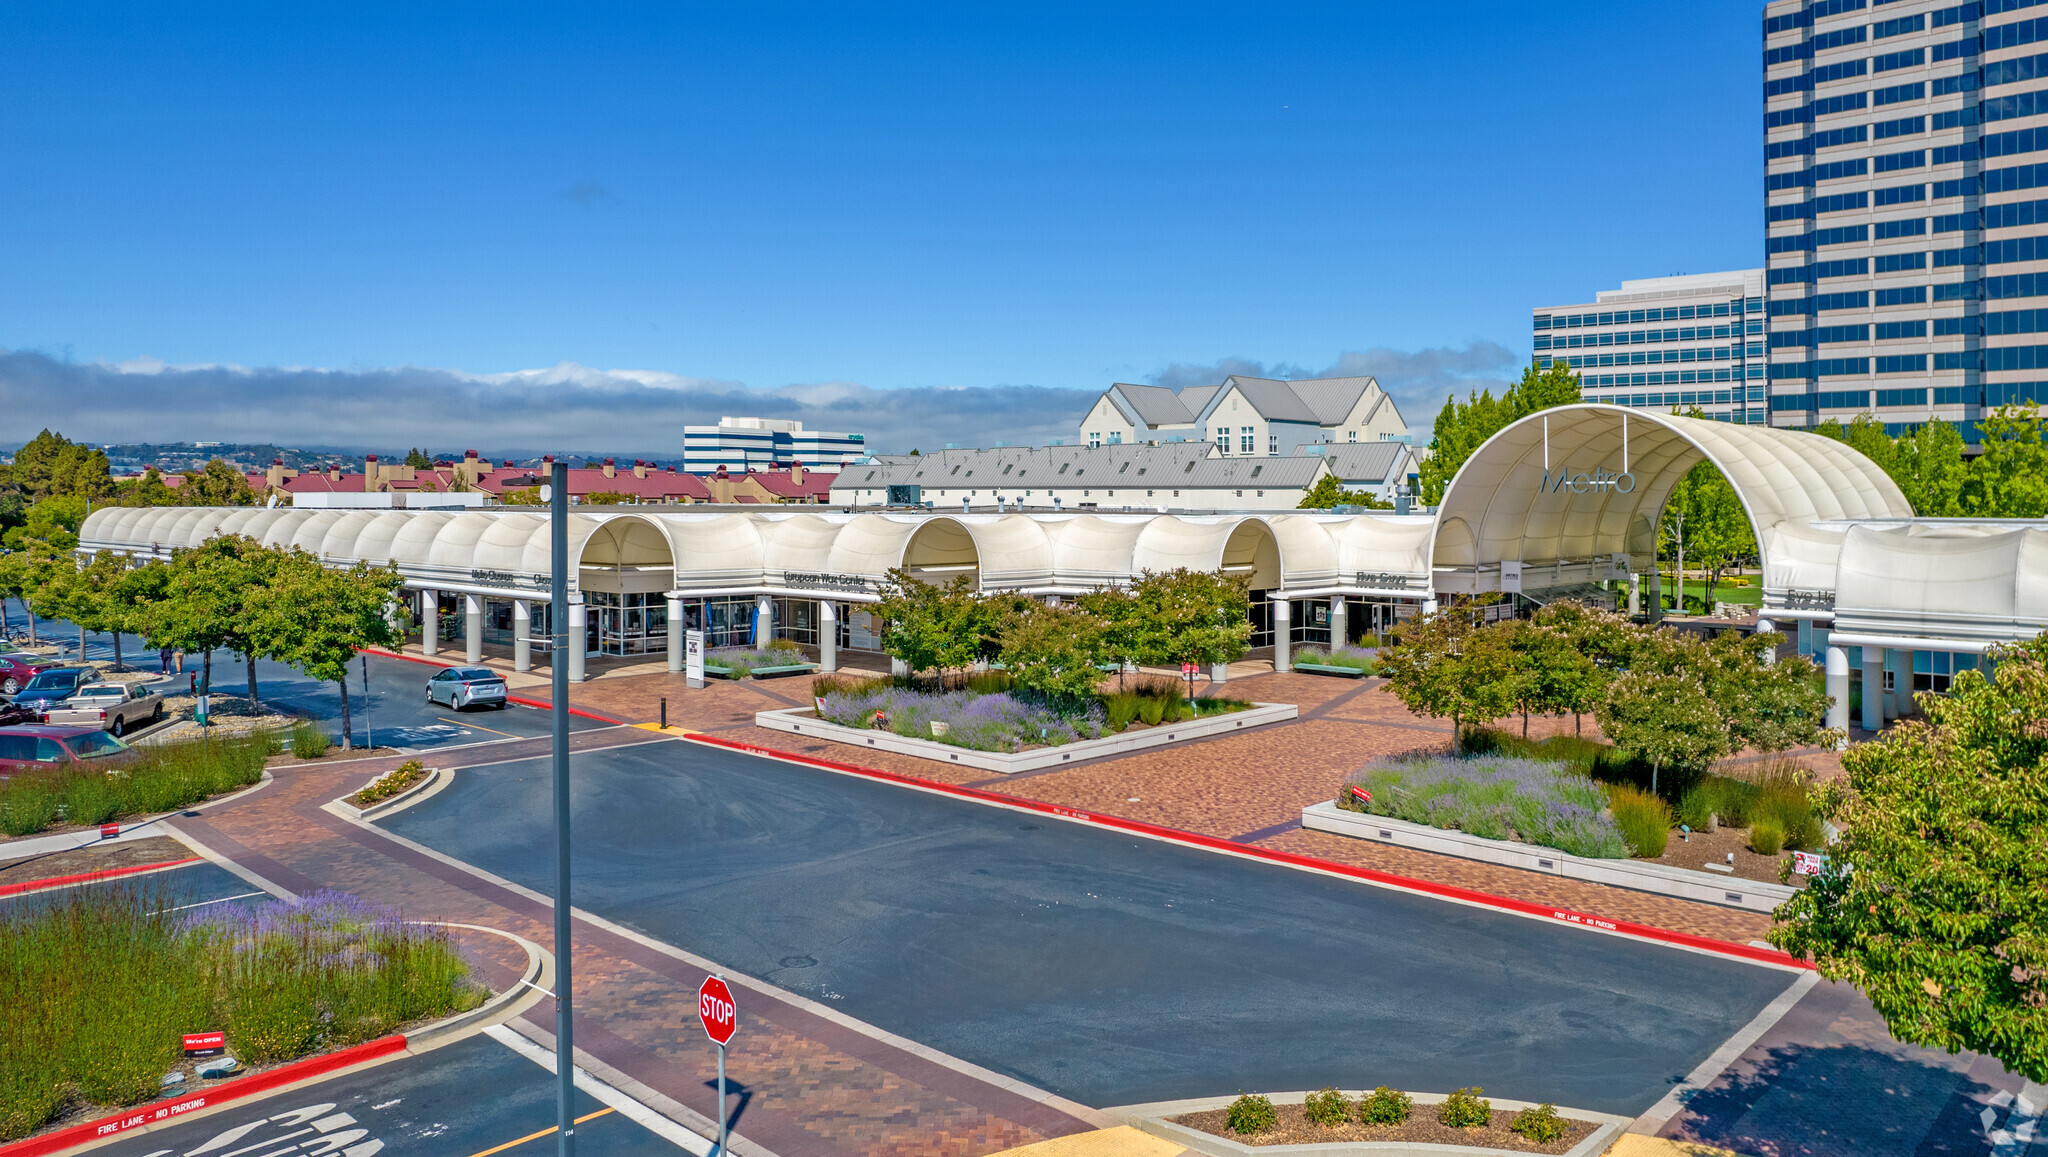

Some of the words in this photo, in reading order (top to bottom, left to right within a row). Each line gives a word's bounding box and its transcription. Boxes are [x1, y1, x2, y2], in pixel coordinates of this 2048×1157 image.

[1540, 466, 1636, 494] Metro
[784, 571, 820, 583] European
[821, 573, 838, 584] Wax
[839, 574, 866, 586] Center
[1356, 571, 1377, 582] Five
[1380, 572, 1407, 585] Guys
[1788, 589, 1812, 603] Eye
[1554, 911, 1566, 920] FIRE
[1567, 914, 1581, 923] LANE
[1595, 919, 1617, 930] PARKING
[702, 993, 733, 1026] STOP
[97, 1122, 118, 1136] FIRE
[121, 1114, 144, 1129] LANE
[155, 1108, 168, 1119] NO
[171, 1098, 205, 1115] PARKING
